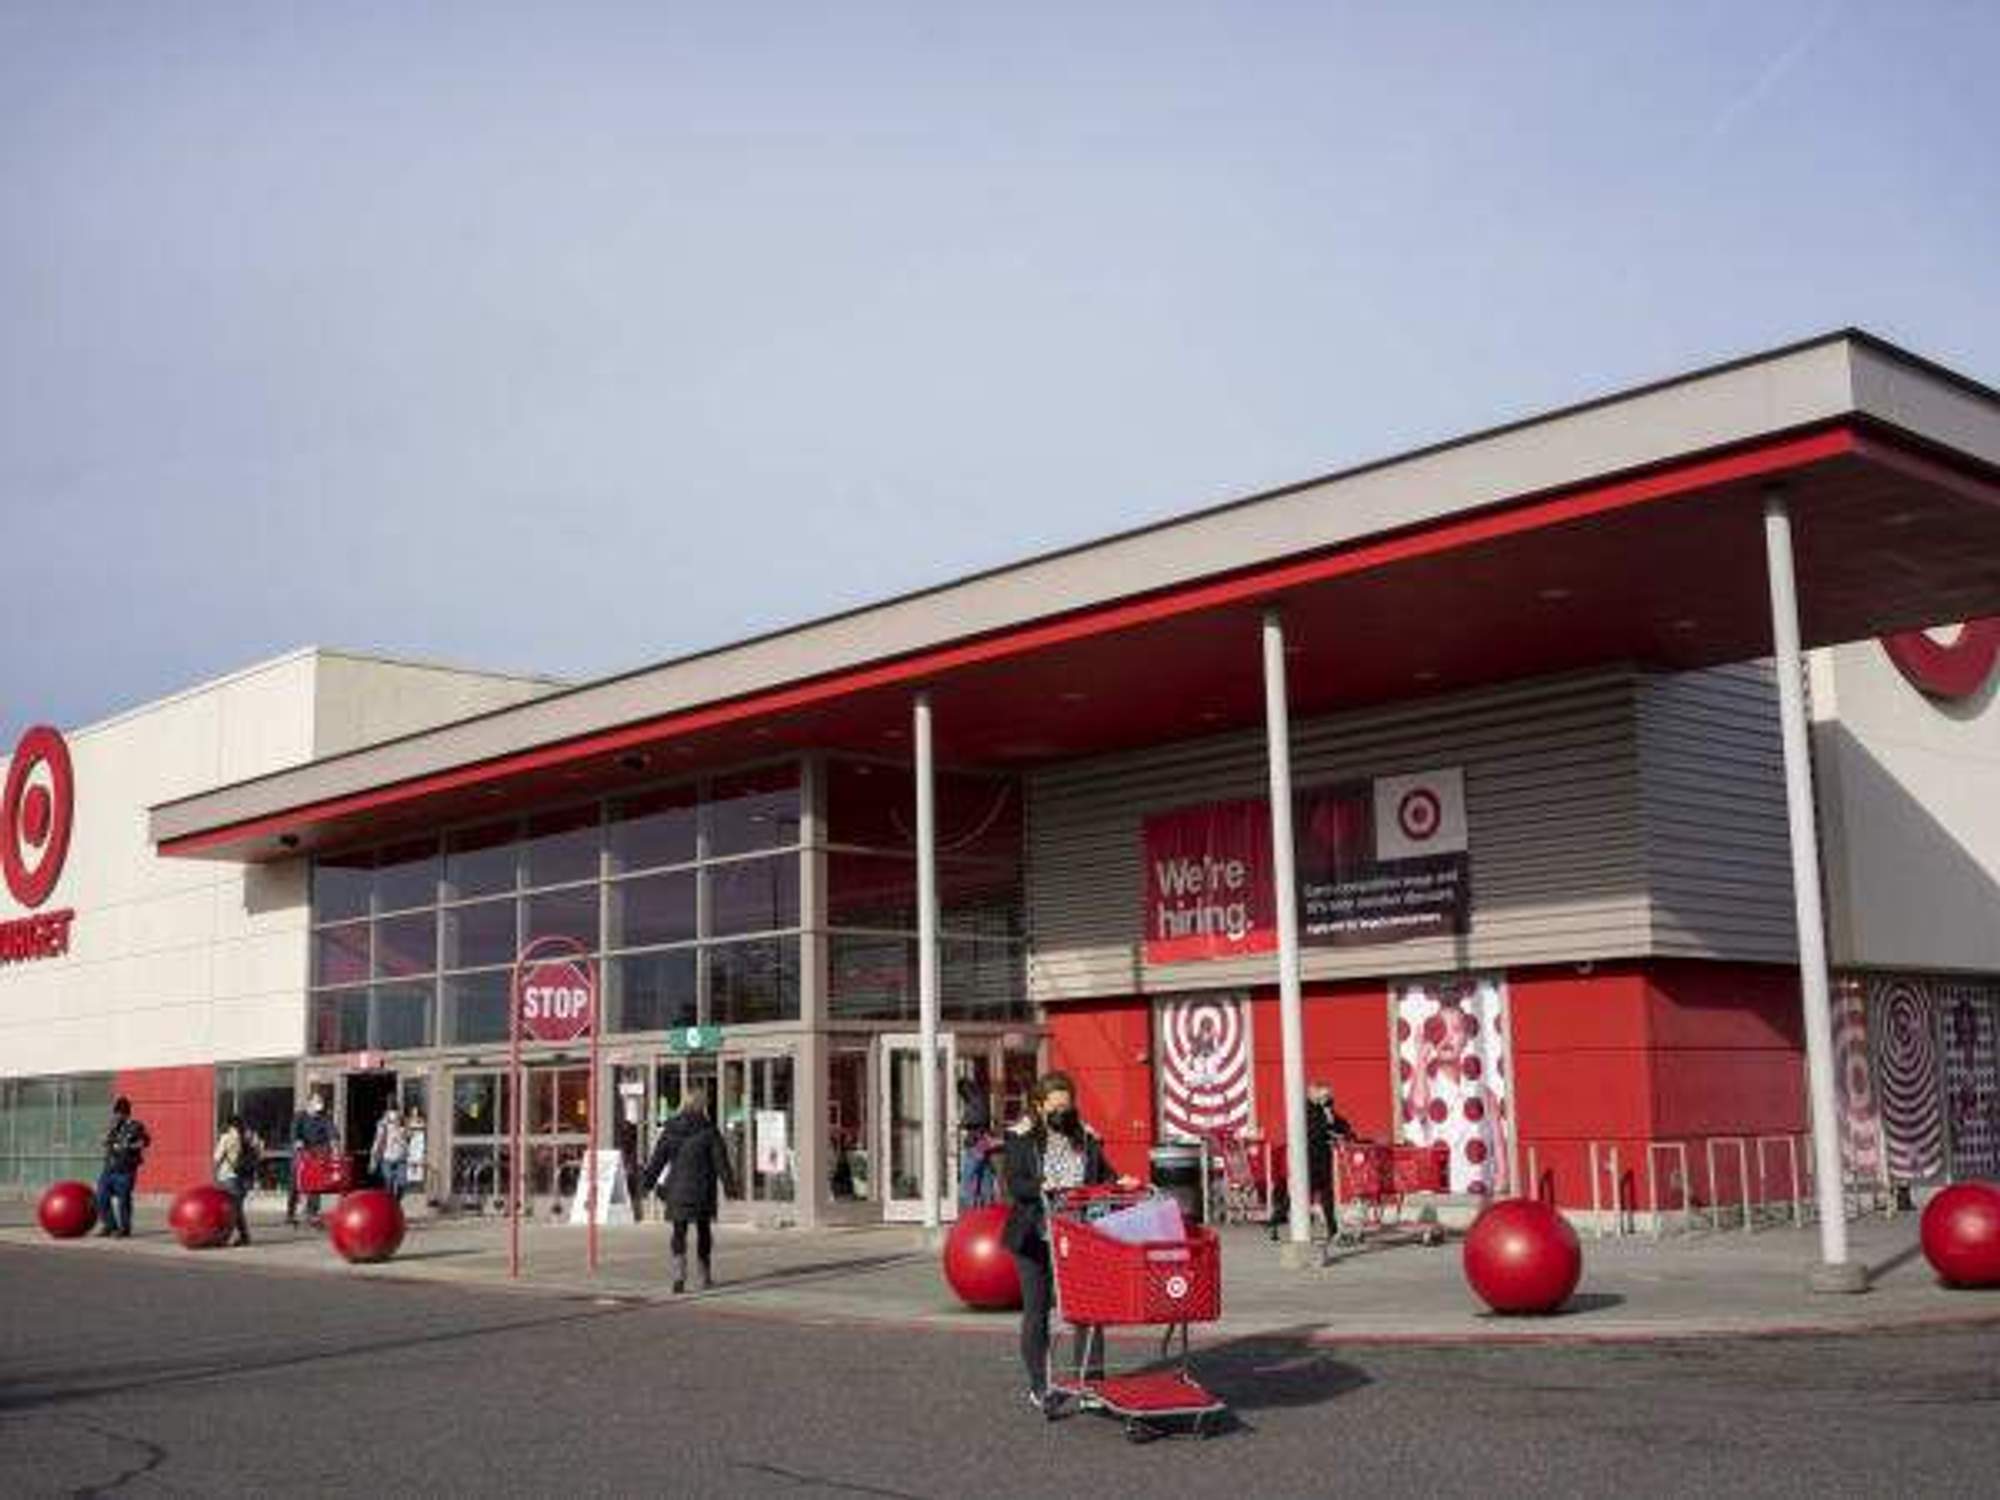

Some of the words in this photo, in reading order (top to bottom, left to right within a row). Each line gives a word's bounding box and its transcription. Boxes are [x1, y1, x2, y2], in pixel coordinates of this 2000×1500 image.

[1157, 856, 1245, 896] We're
[1158, 897, 1254, 941] hiring.
[523, 986, 588, 1019] STOP
